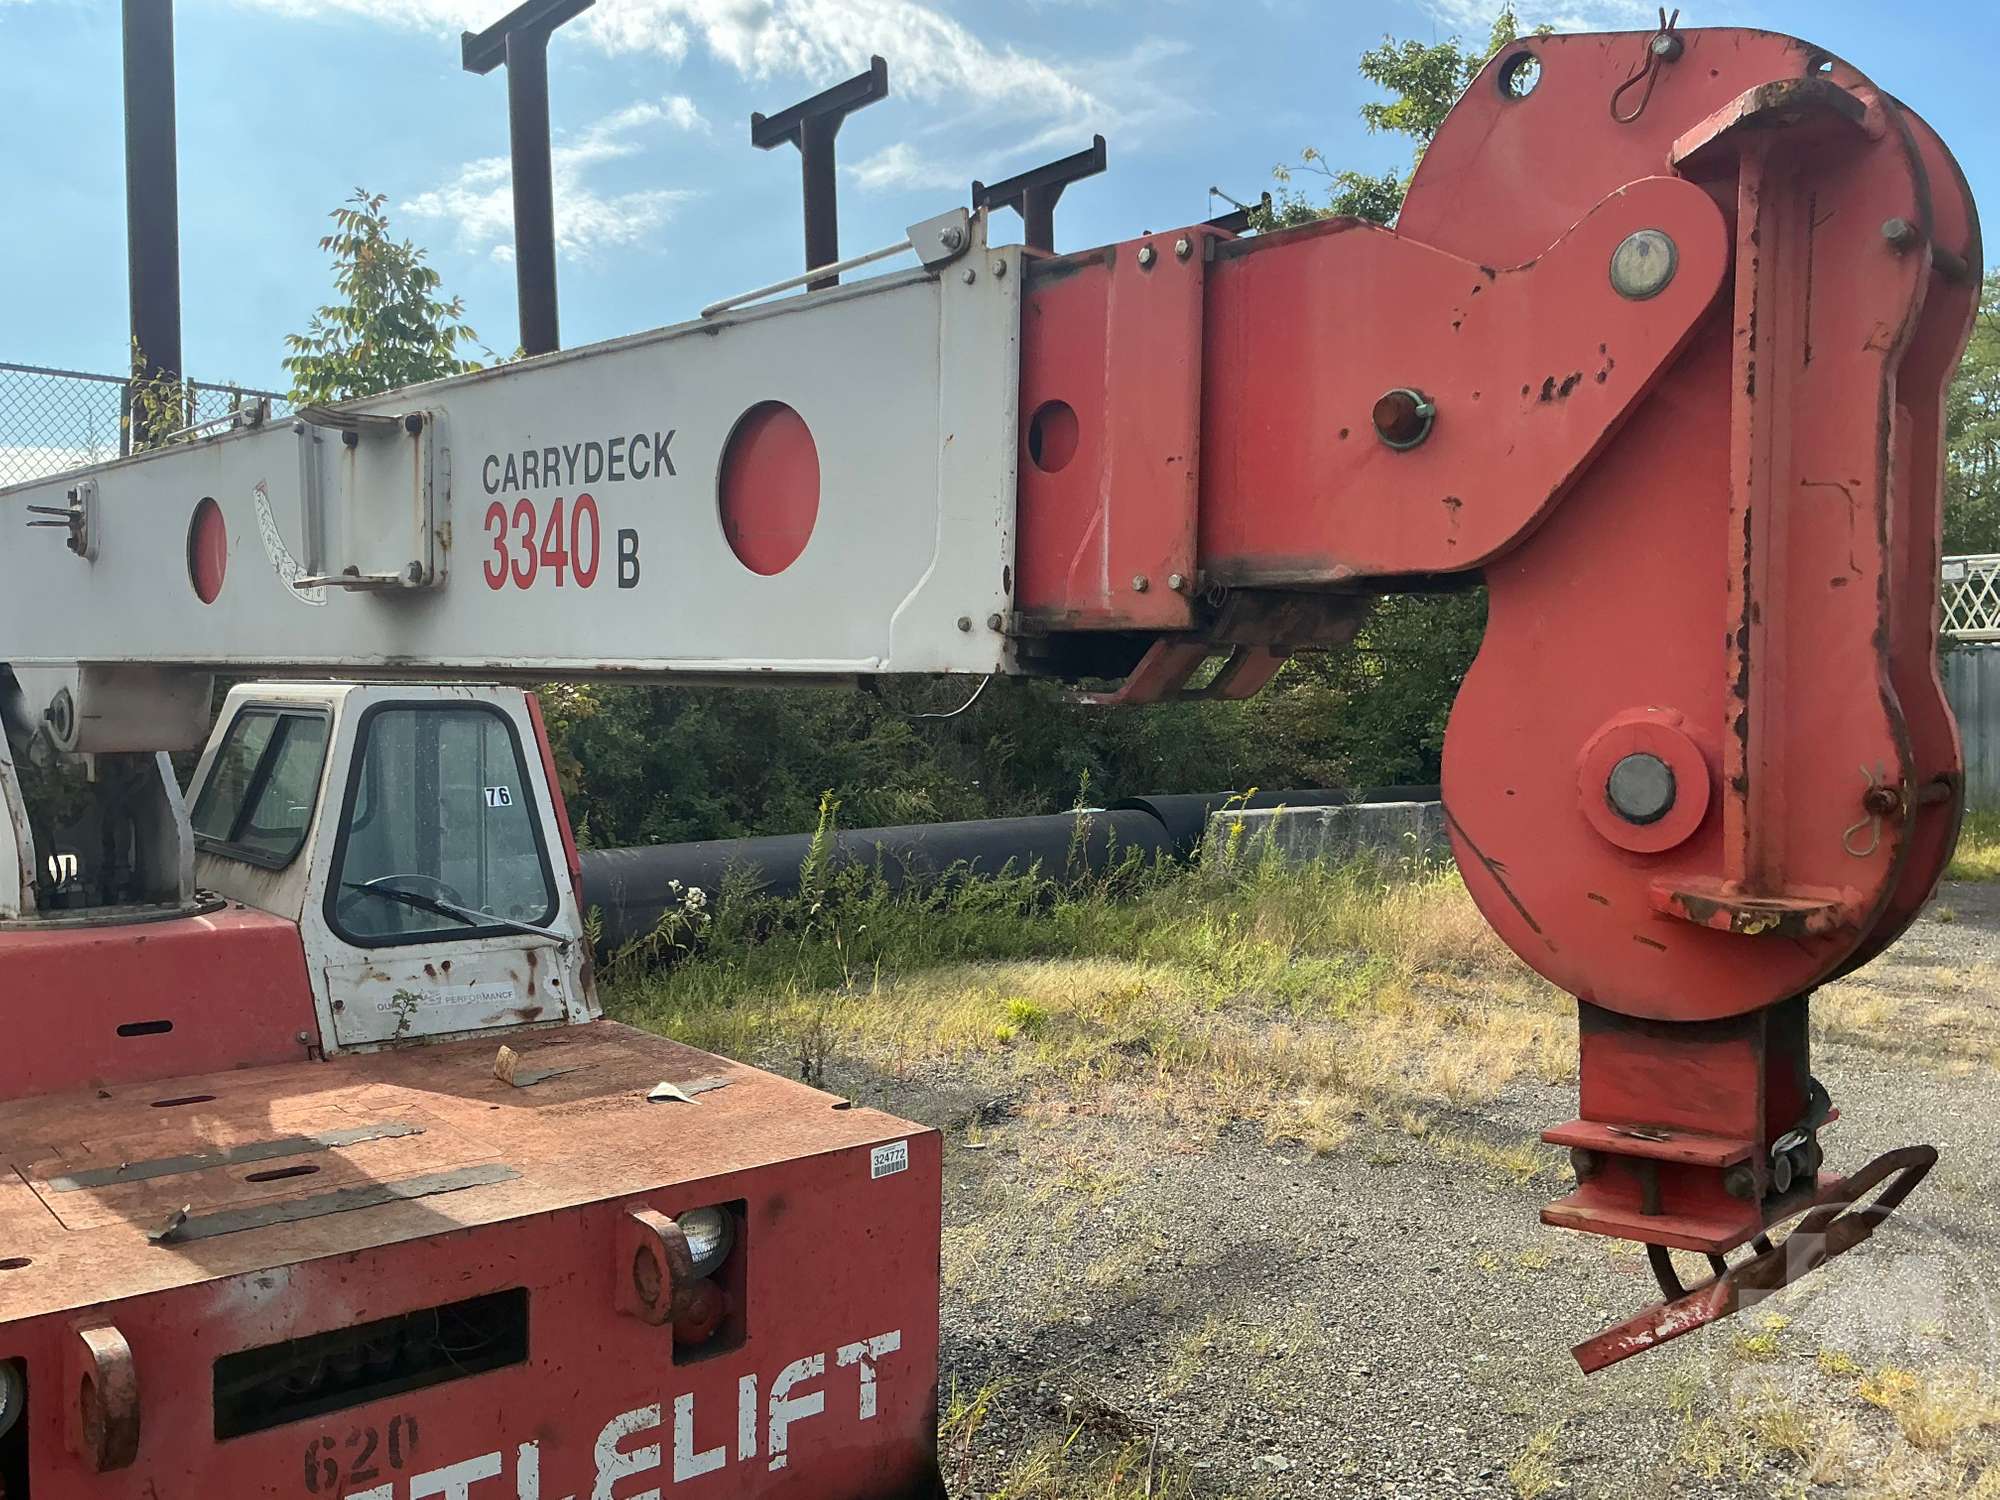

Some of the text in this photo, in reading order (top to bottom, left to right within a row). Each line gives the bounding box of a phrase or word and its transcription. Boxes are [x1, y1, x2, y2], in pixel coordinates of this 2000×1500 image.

[482, 429, 677, 494] CARRYDECK
[483, 493, 640, 590] 3340 B
[486, 788, 510, 806] 76
[445, 991, 513, 1004] PERFORMANCE
[874, 1148, 905, 1166] 324772
[304, 1414, 418, 1494] 620
